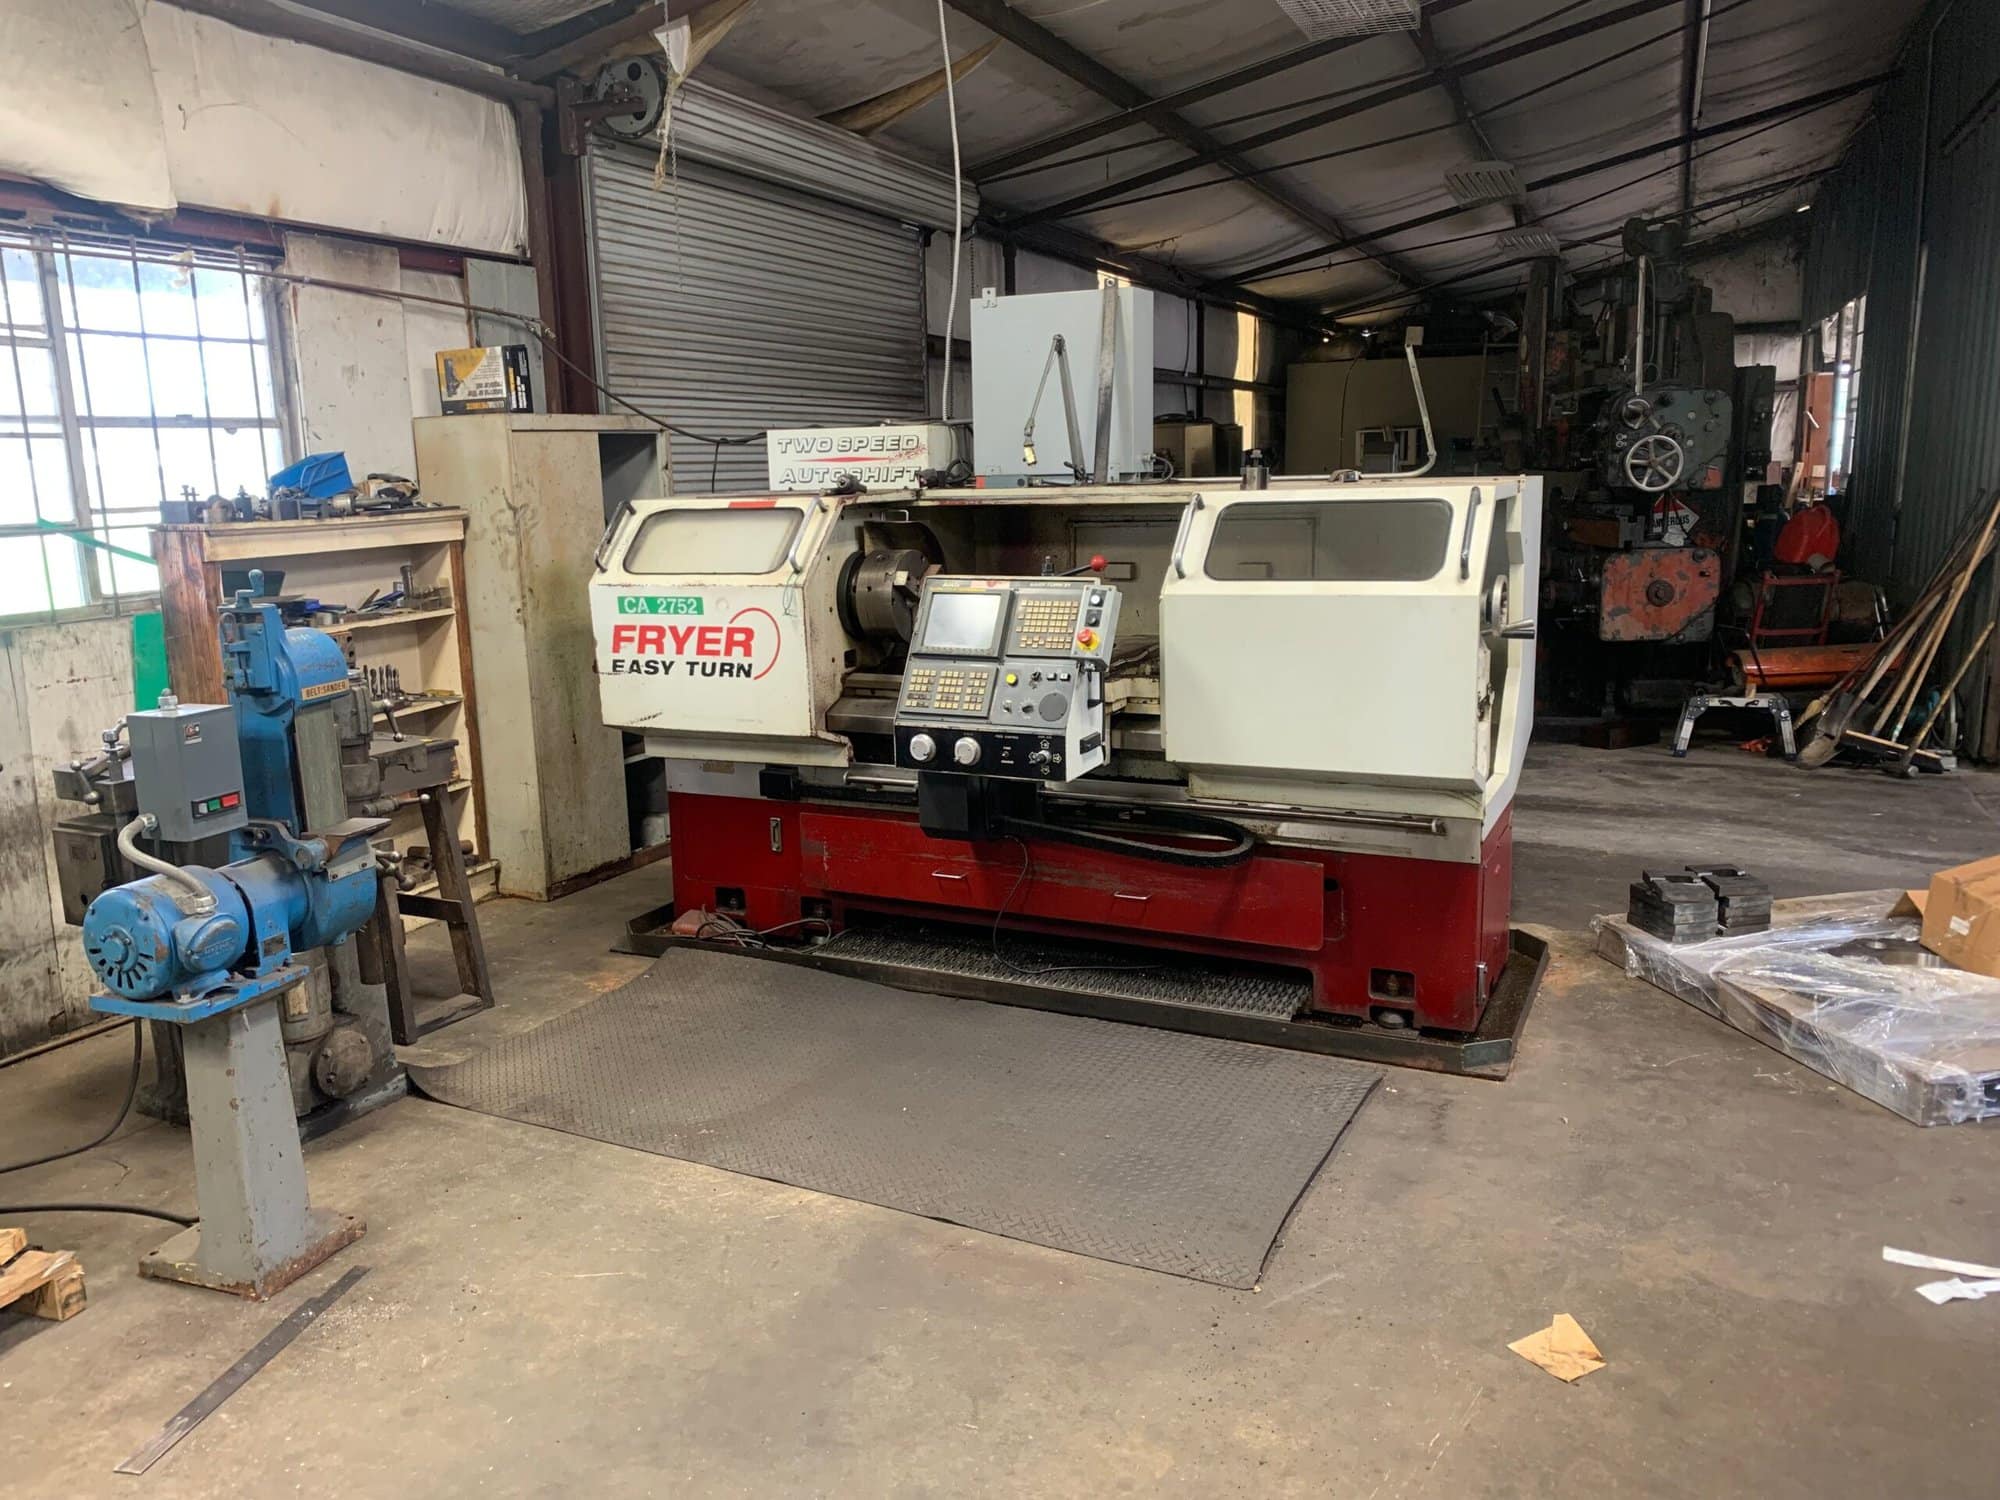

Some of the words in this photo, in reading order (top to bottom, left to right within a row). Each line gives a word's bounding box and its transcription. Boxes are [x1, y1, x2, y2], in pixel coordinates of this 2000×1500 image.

[777, 437, 833, 454] TWO
[837, 434, 920, 453] SPEED
[779, 466, 922, 484] AUTOSHIFT
[623, 596, 650, 614] CA
[657, 597, 698, 614] 2752
[611, 624, 755, 657] FRYER
[611, 659, 675, 676] EASY
[686, 661, 753, 678] TURN
[306, 686, 321, 698] BELT
